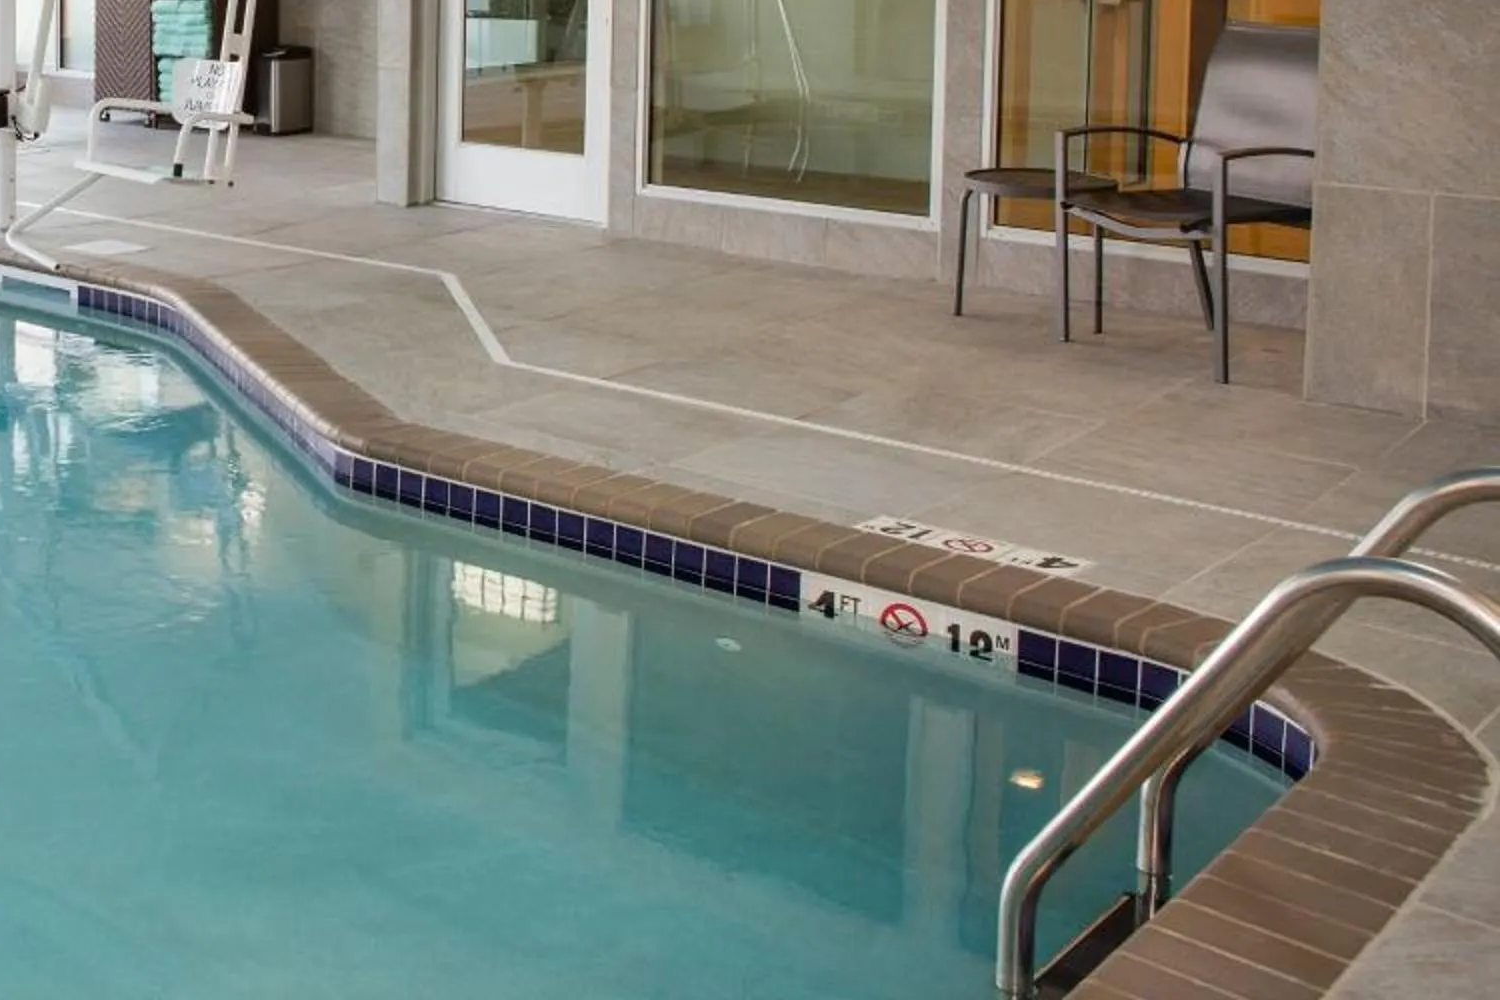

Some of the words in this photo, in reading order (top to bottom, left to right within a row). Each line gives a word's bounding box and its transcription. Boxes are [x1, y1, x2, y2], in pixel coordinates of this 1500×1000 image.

[807, 590, 835, 620] 4
[840, 594, 862, 615] FT
[995, 634, 1010, 652] M
